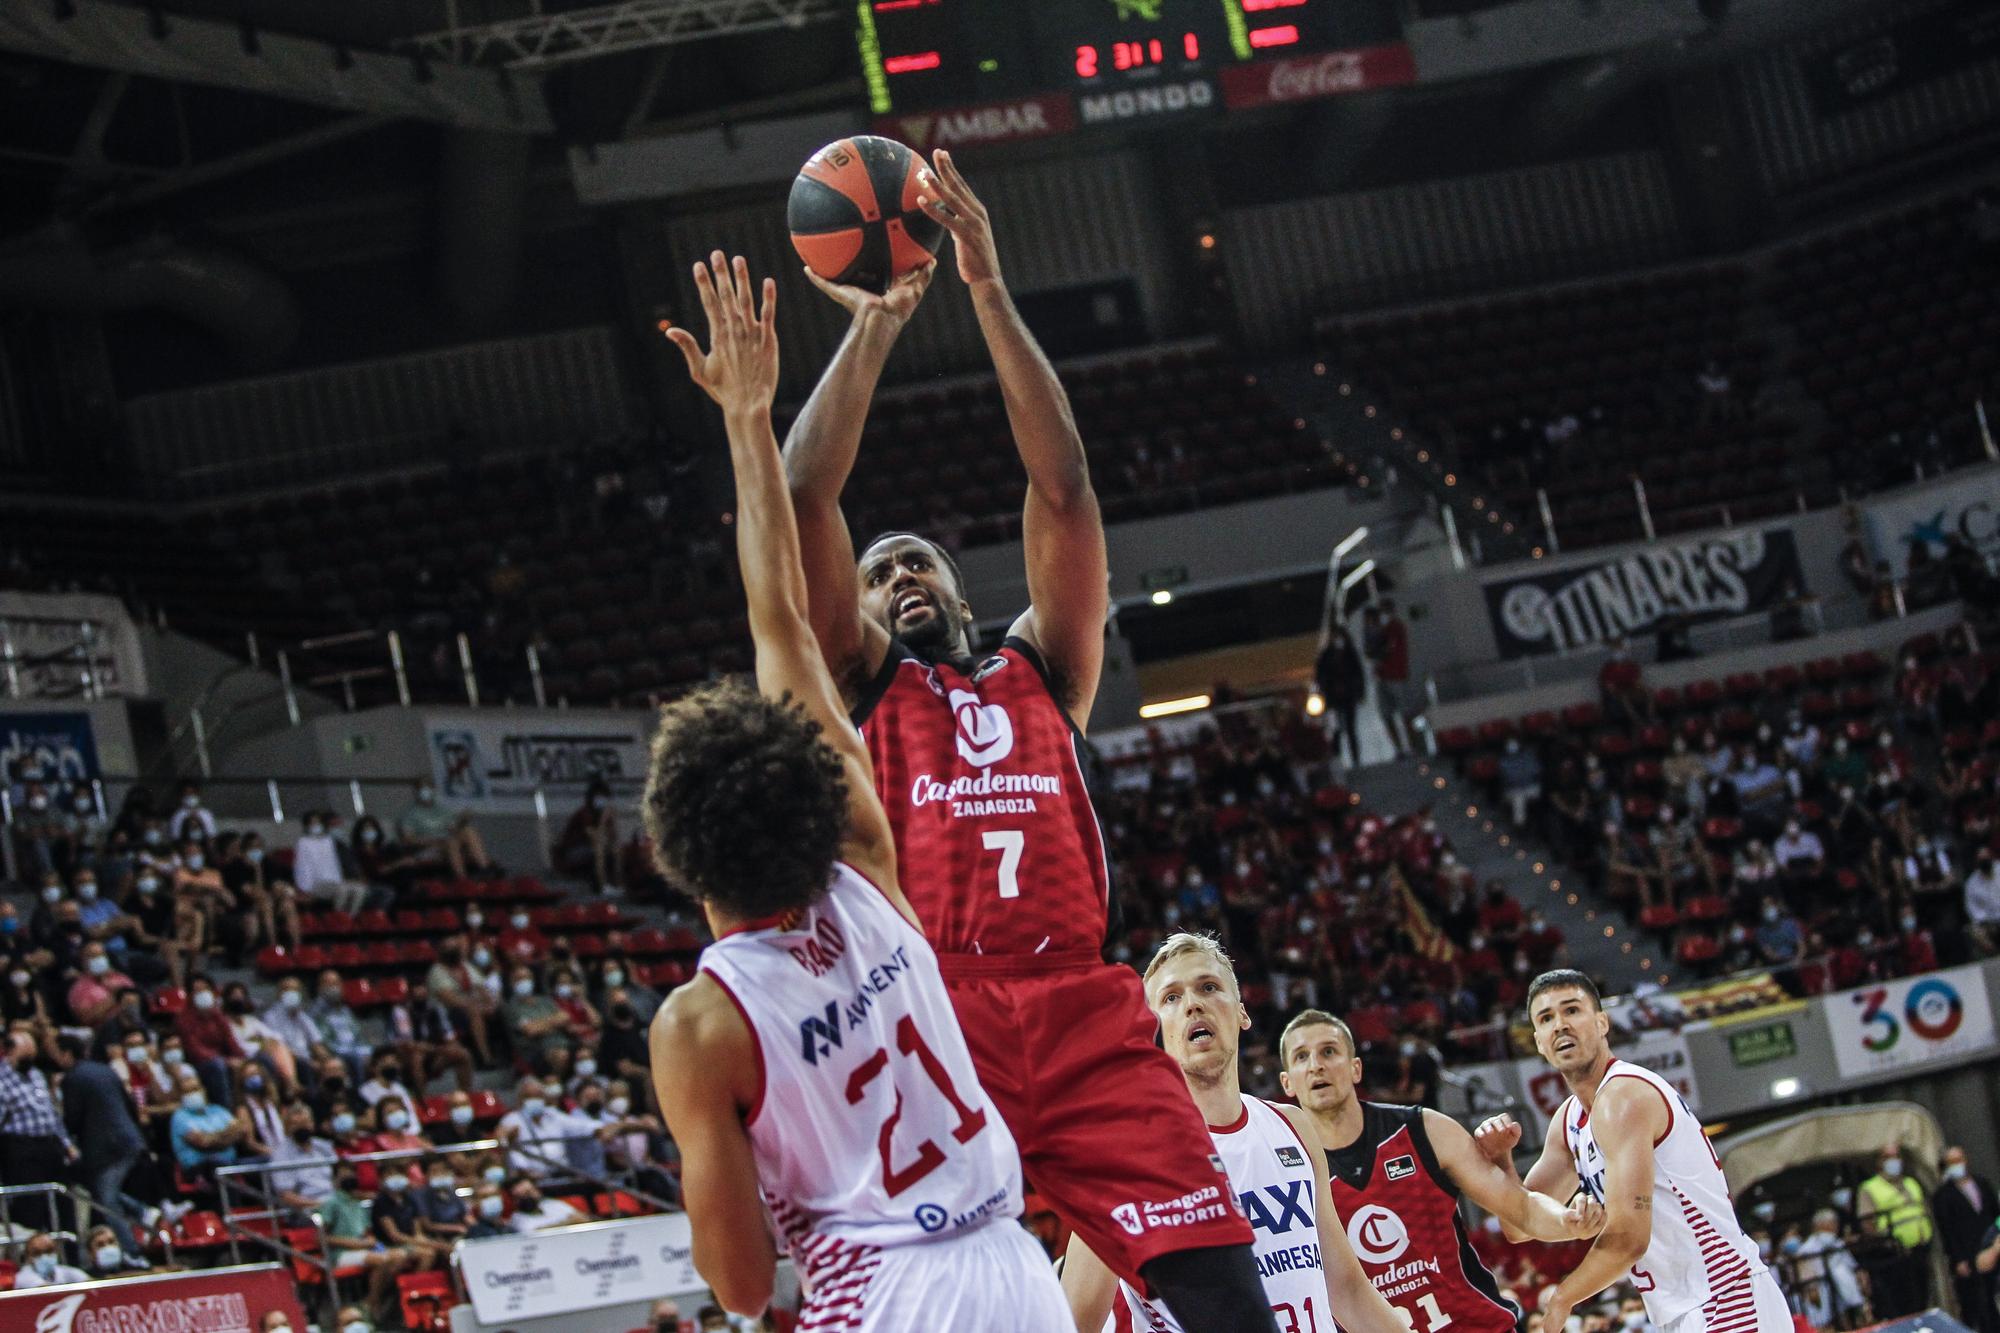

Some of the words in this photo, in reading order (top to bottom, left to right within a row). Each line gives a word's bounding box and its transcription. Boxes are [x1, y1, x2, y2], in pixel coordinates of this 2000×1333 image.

[935, 101, 1048, 144] AMBAR
[1081, 80, 1212, 123] MONDO
[911, 767, 1061, 807] Casademon
[953, 797, 1037, 817] ZARAGOZA
[981, 830, 1025, 899] 7
[1853, 979, 1962, 1051] 30
[845, 1013, 988, 1199] 21
[1255, 1243, 1323, 1278] ANRESA
[1380, 1275, 1430, 1299] ARAGOZA
